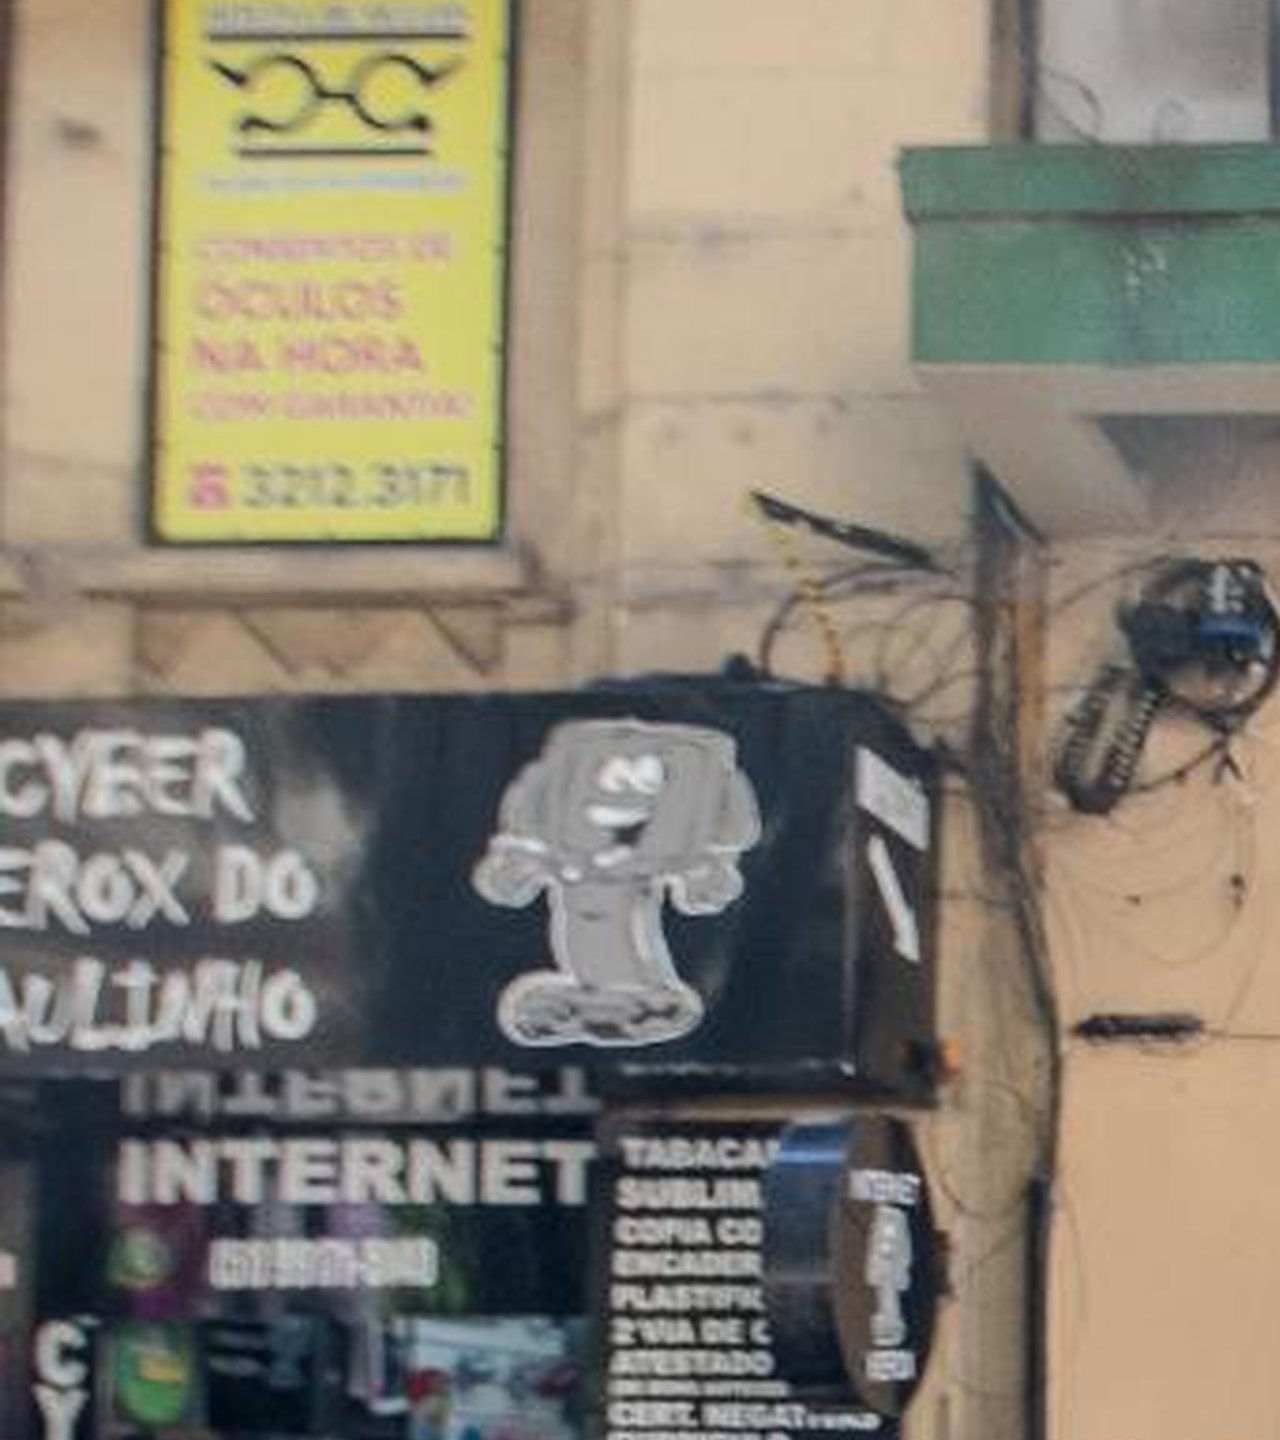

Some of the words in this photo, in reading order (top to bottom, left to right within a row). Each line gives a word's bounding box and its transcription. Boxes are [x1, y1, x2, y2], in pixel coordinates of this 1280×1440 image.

[191, 334, 266, 372] NA
[283, 334, 426, 373] HORA
[0, 727, 256, 823] CYBER
[214, 845, 317, 922] DO
[119, 1139, 597, 1206] INTERNET
